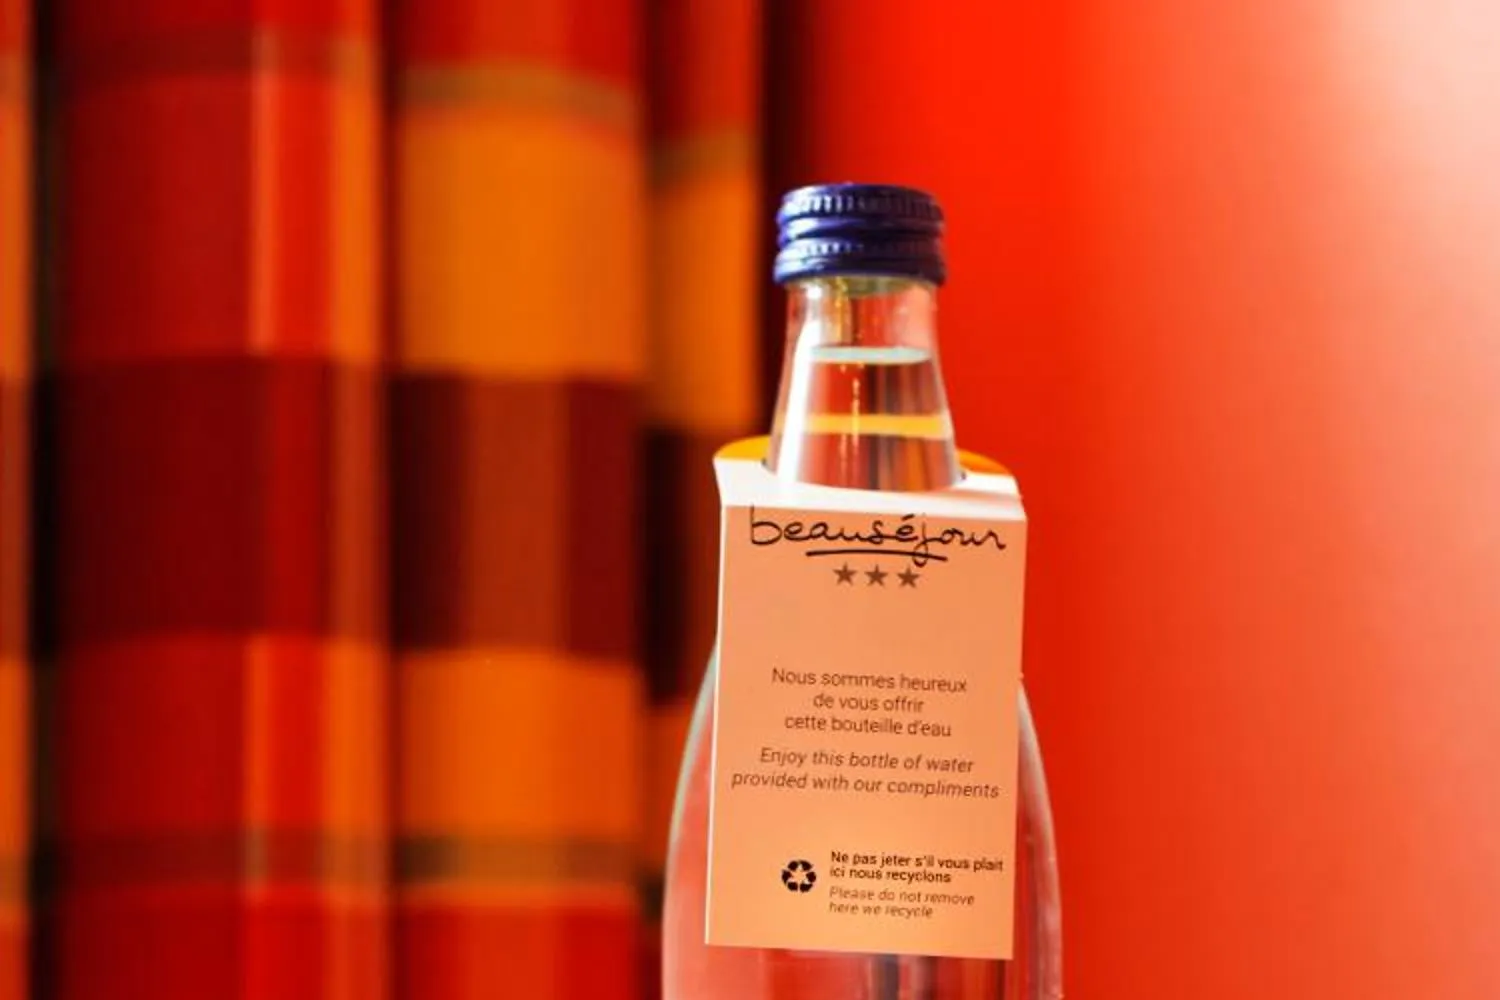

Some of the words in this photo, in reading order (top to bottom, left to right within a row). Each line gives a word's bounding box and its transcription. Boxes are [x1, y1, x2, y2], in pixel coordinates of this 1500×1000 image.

[751, 504, 1006, 567] beauséjour
[772, 668, 816, 685] Nous
[821, 673, 895, 690] sommes
[900, 673, 967, 693] heureux
[814, 693, 834, 708] de
[839, 698, 878, 712] vous
[883, 695, 924, 713] offrir
[785, 715, 826, 731] cette
[832, 716, 903, 735] bouteille
[907, 720, 952, 738] d'eau
[760, 747, 807, 767] Enjoy
[812, 750, 844, 766] this
[849, 751, 898, 769] bottle
[903, 753, 921, 770] of
[926, 757, 974, 774] water
[732, 771, 807, 789] provided
[812, 774, 848, 791] with
[853, 779, 881, 792] our
[887, 778, 999, 799] compliments
[831, 851, 849, 863] Ne
[852, 853, 877, 866] pas
[880, 854, 911, 868] jeter
[938, 858, 970, 870] vous
[829, 866, 845, 877] ici
[849, 868, 882, 880] nous
[886, 869, 952, 884] recyclons
[829, 886, 875, 901] Please
[878, 888, 895, 901] do
[899, 890, 921, 902] not
[924, 893, 975, 906] remove
[829, 901, 859, 915] here
[862, 905, 882, 916] we
[885, 904, 933, 919] recycle
